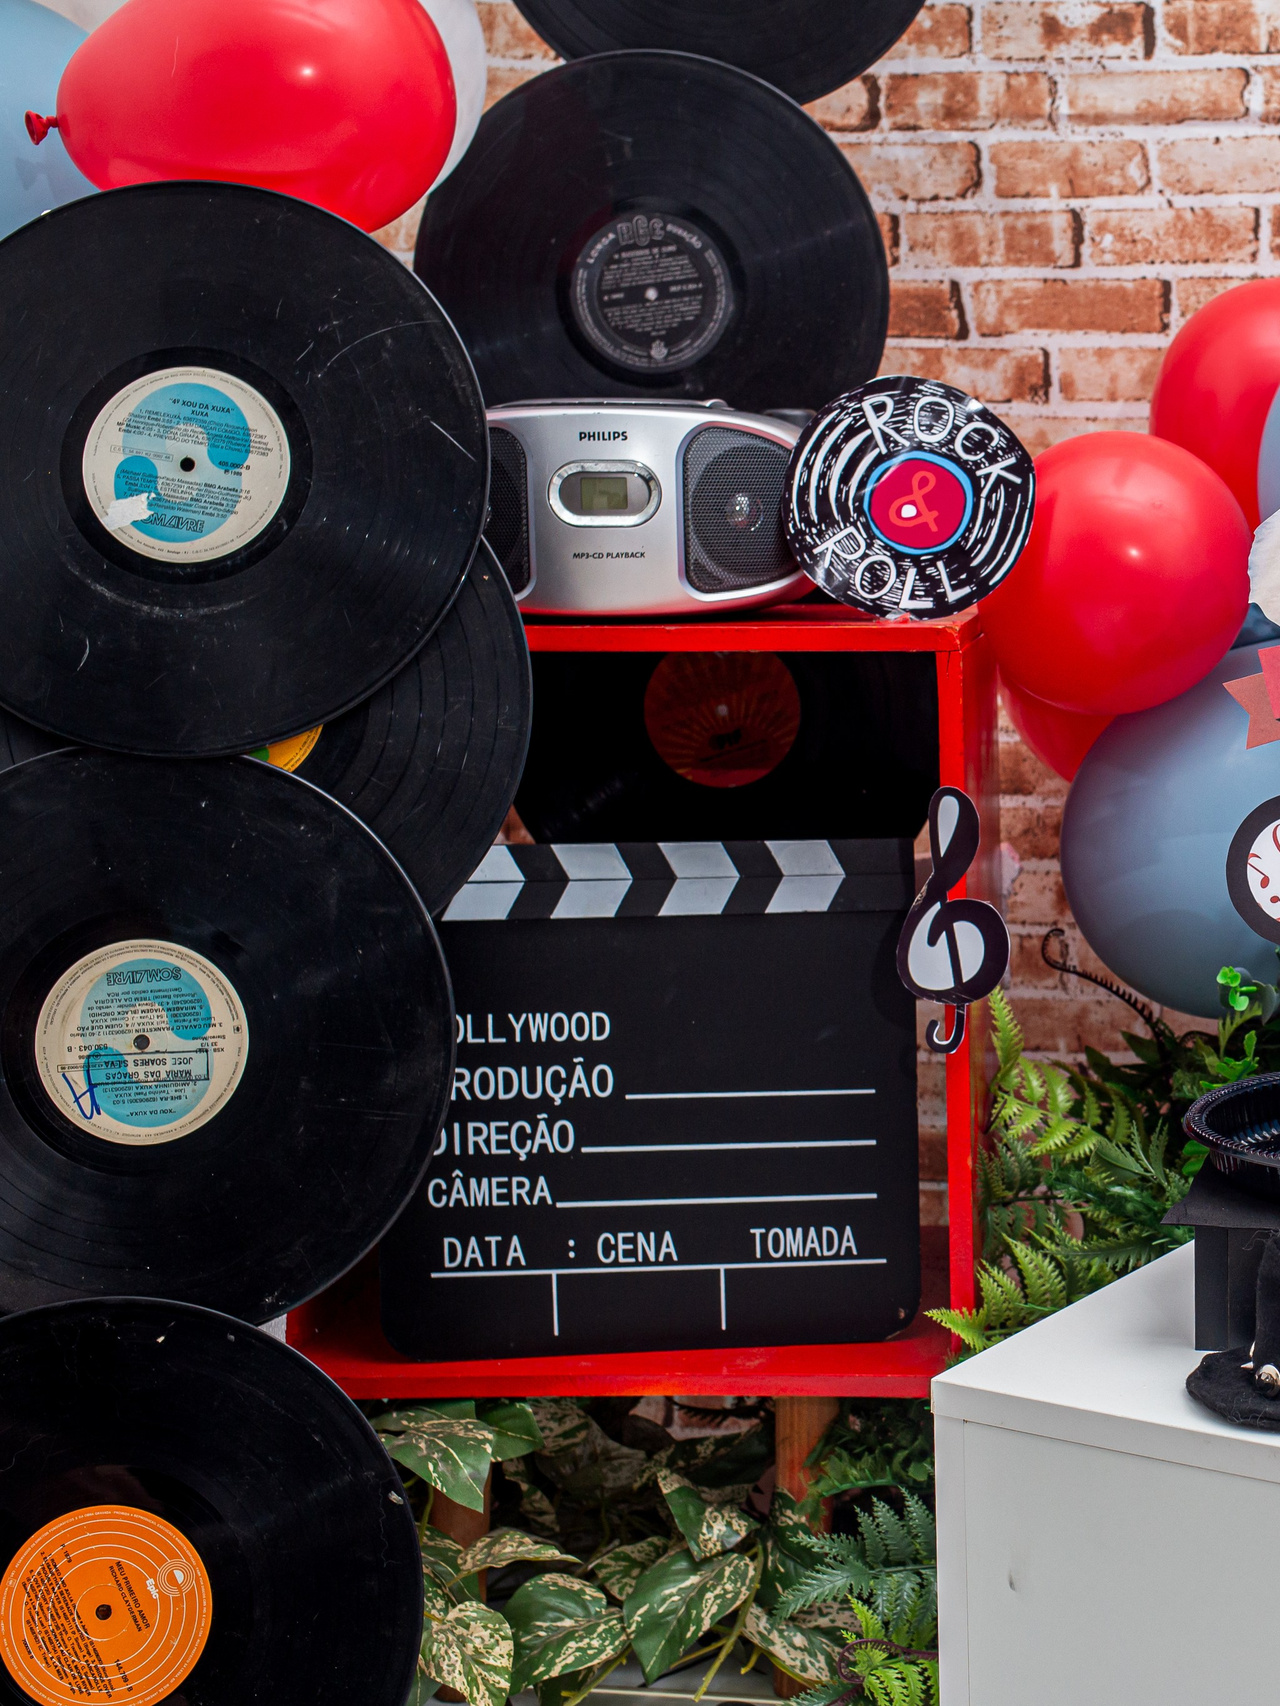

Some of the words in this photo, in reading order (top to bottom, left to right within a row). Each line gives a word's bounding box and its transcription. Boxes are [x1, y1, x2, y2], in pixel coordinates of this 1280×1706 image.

[181, 400, 197, 408] XOU
[191, 410, 209, 418] XUXA
[578, 431, 628, 442] PHILIPS
[861, 395, 1023, 498] ROCK
[888, 470, 940, 533] &
[572, 552, 604, 560] MP3-CD
[605, 551, 646, 560] PLAYBACK
[812, 525, 972, 610] ROLL
[455, 1011, 611, 1044] LLYWOOD
[133, 1057, 167, 1067] SOARES
[144, 1070, 161, 1078] DAS
[165, 1068, 192, 1077] MARIA
[105, 1071, 139, 1081] GRAÇAS
[450, 1056, 614, 1105] RODUÇÃO
[427, 1169, 553, 1209] CÂMERA
[443, 1235, 526, 1268] DATA
[597, 1230, 678, 1263] CENA
[750, 1224, 857, 1260] TOMADA
[108, 1565, 124, 1592] RICHARD
[121, 1591, 144, 1632] CLAYDERMAN
[115, 1561, 127, 1577] MEU
[122, 1576, 142, 1609] PRIMEIRO
[137, 1608, 151, 1630] AMOR
[146, 1578, 160, 1600] Epic
